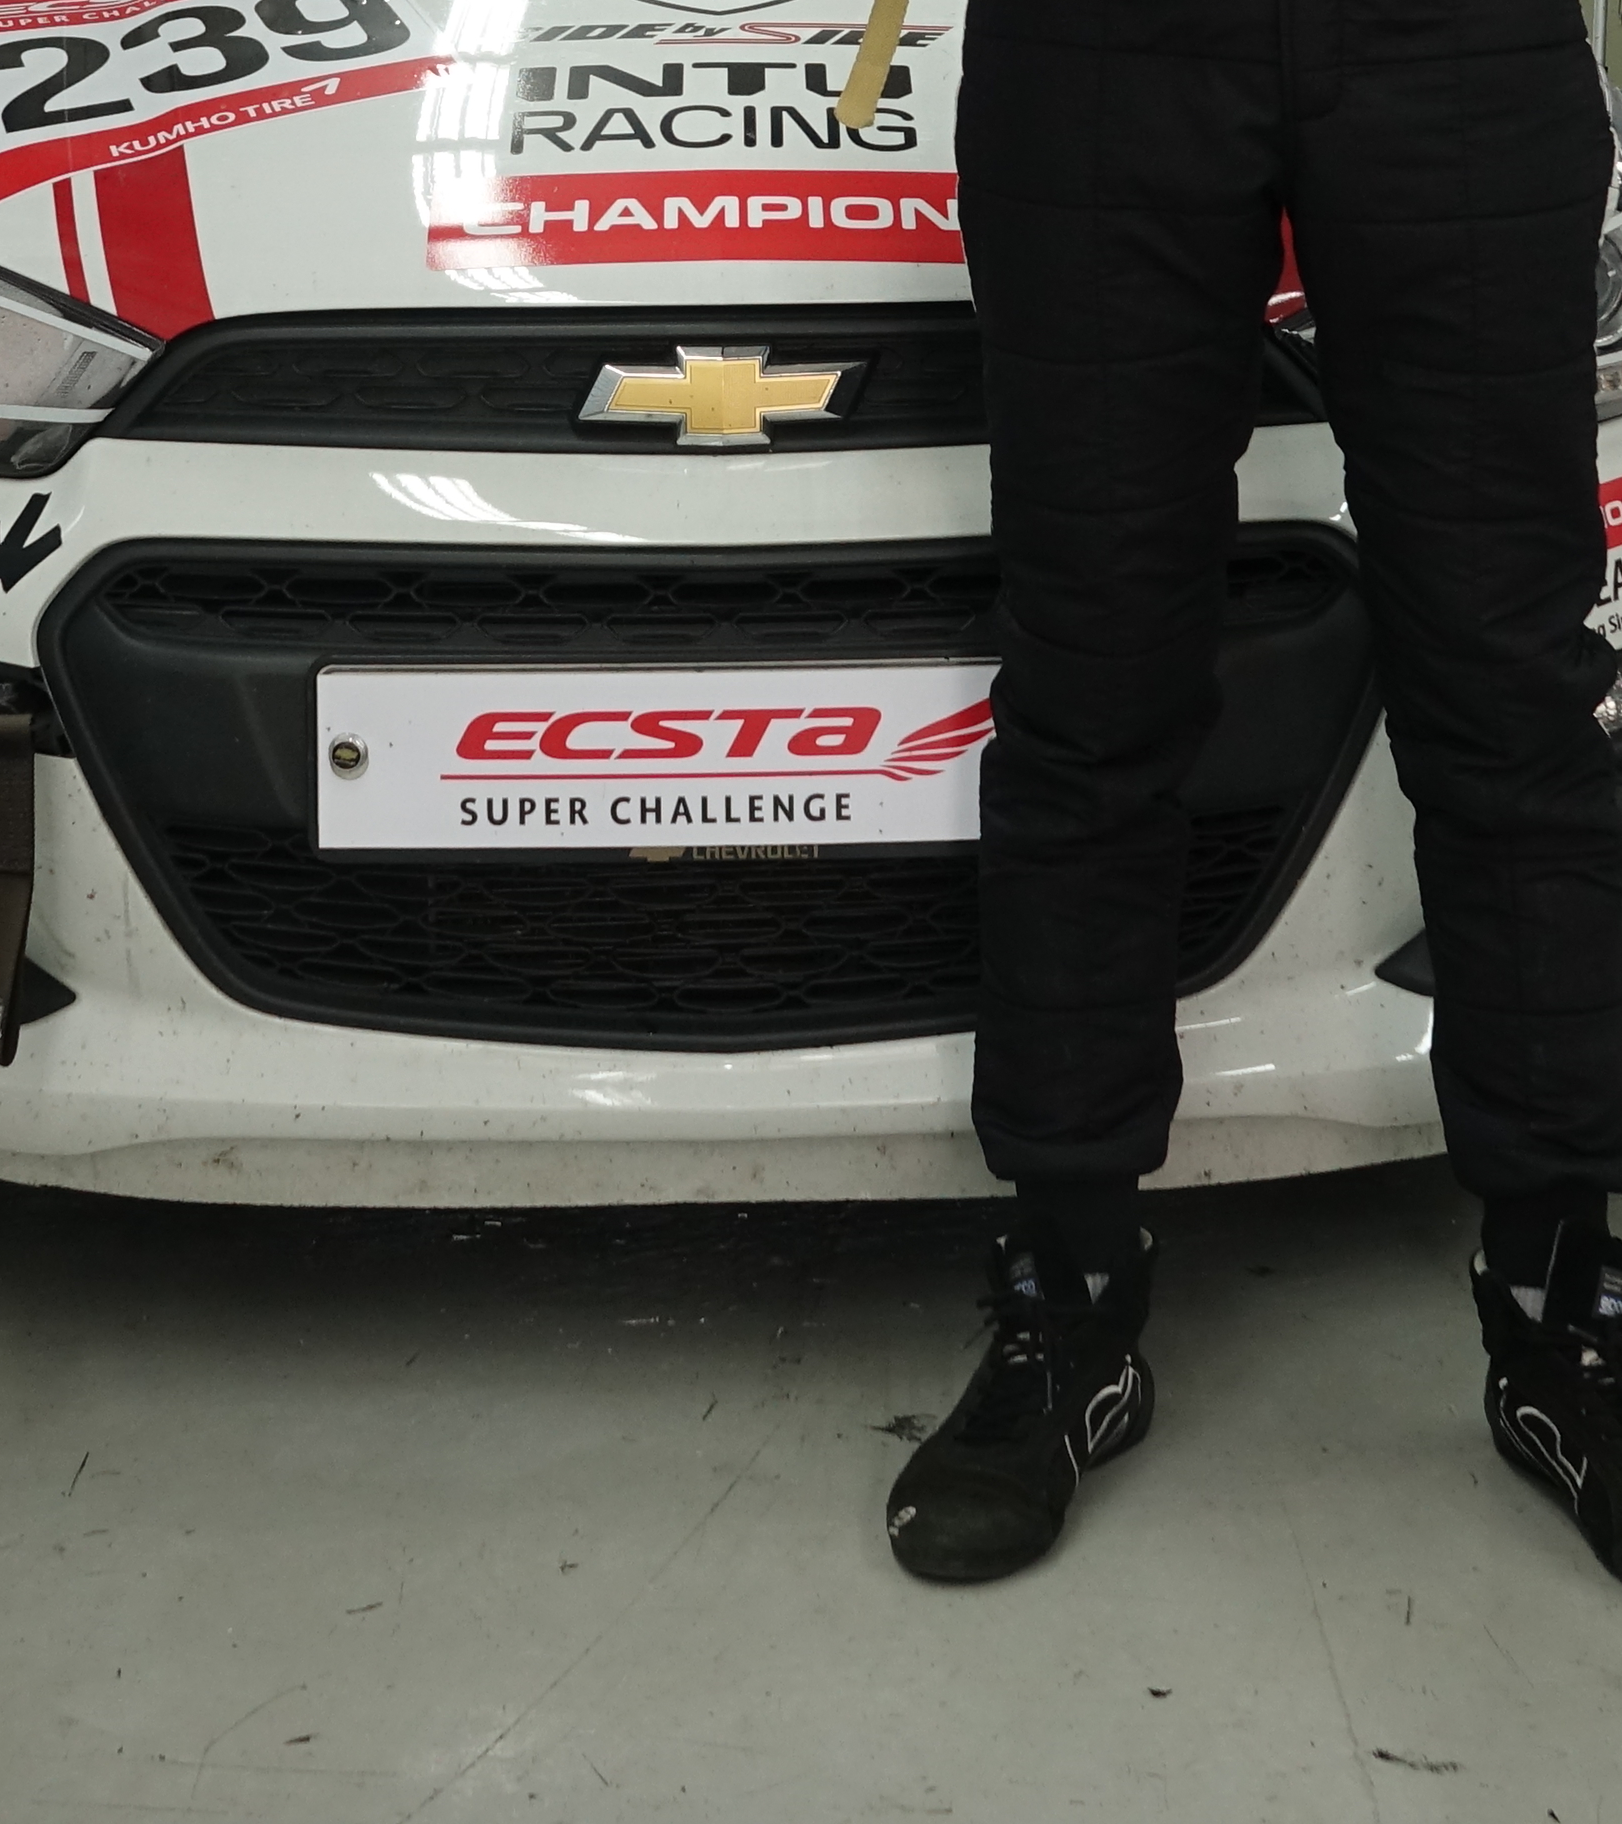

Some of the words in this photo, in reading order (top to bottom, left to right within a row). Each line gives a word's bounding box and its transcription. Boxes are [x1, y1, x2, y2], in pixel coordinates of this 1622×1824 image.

[109, 110, 237, 158] KUMHO
[239, 91, 317, 119] TIRE
[509, 105, 918, 156] RACING
[459, 796, 589, 828] SUPER
[609, 793, 852, 825] CHALLENGE
